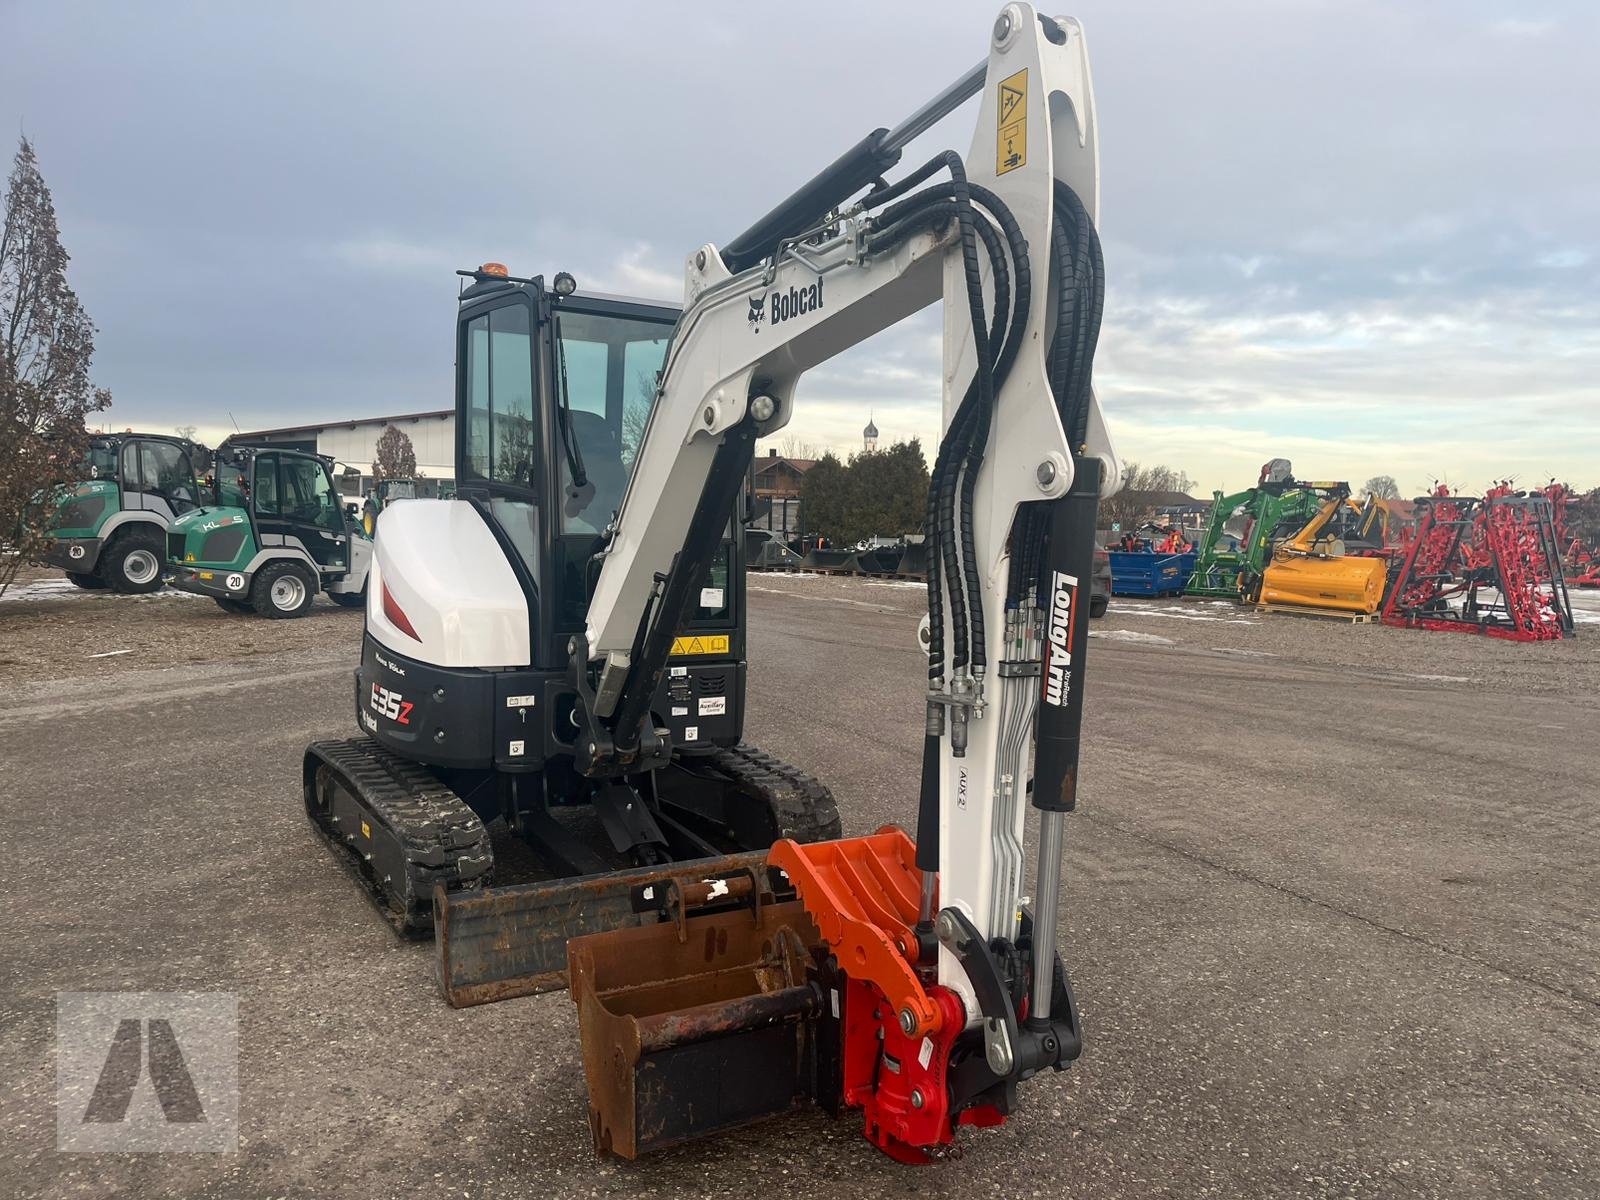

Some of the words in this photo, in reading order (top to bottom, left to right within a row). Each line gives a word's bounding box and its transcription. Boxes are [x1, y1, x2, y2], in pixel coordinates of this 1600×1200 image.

[771, 276, 824, 326] Bobcat
[230, 576, 241, 588] 20
[1046, 572, 1078, 706] LongArm
